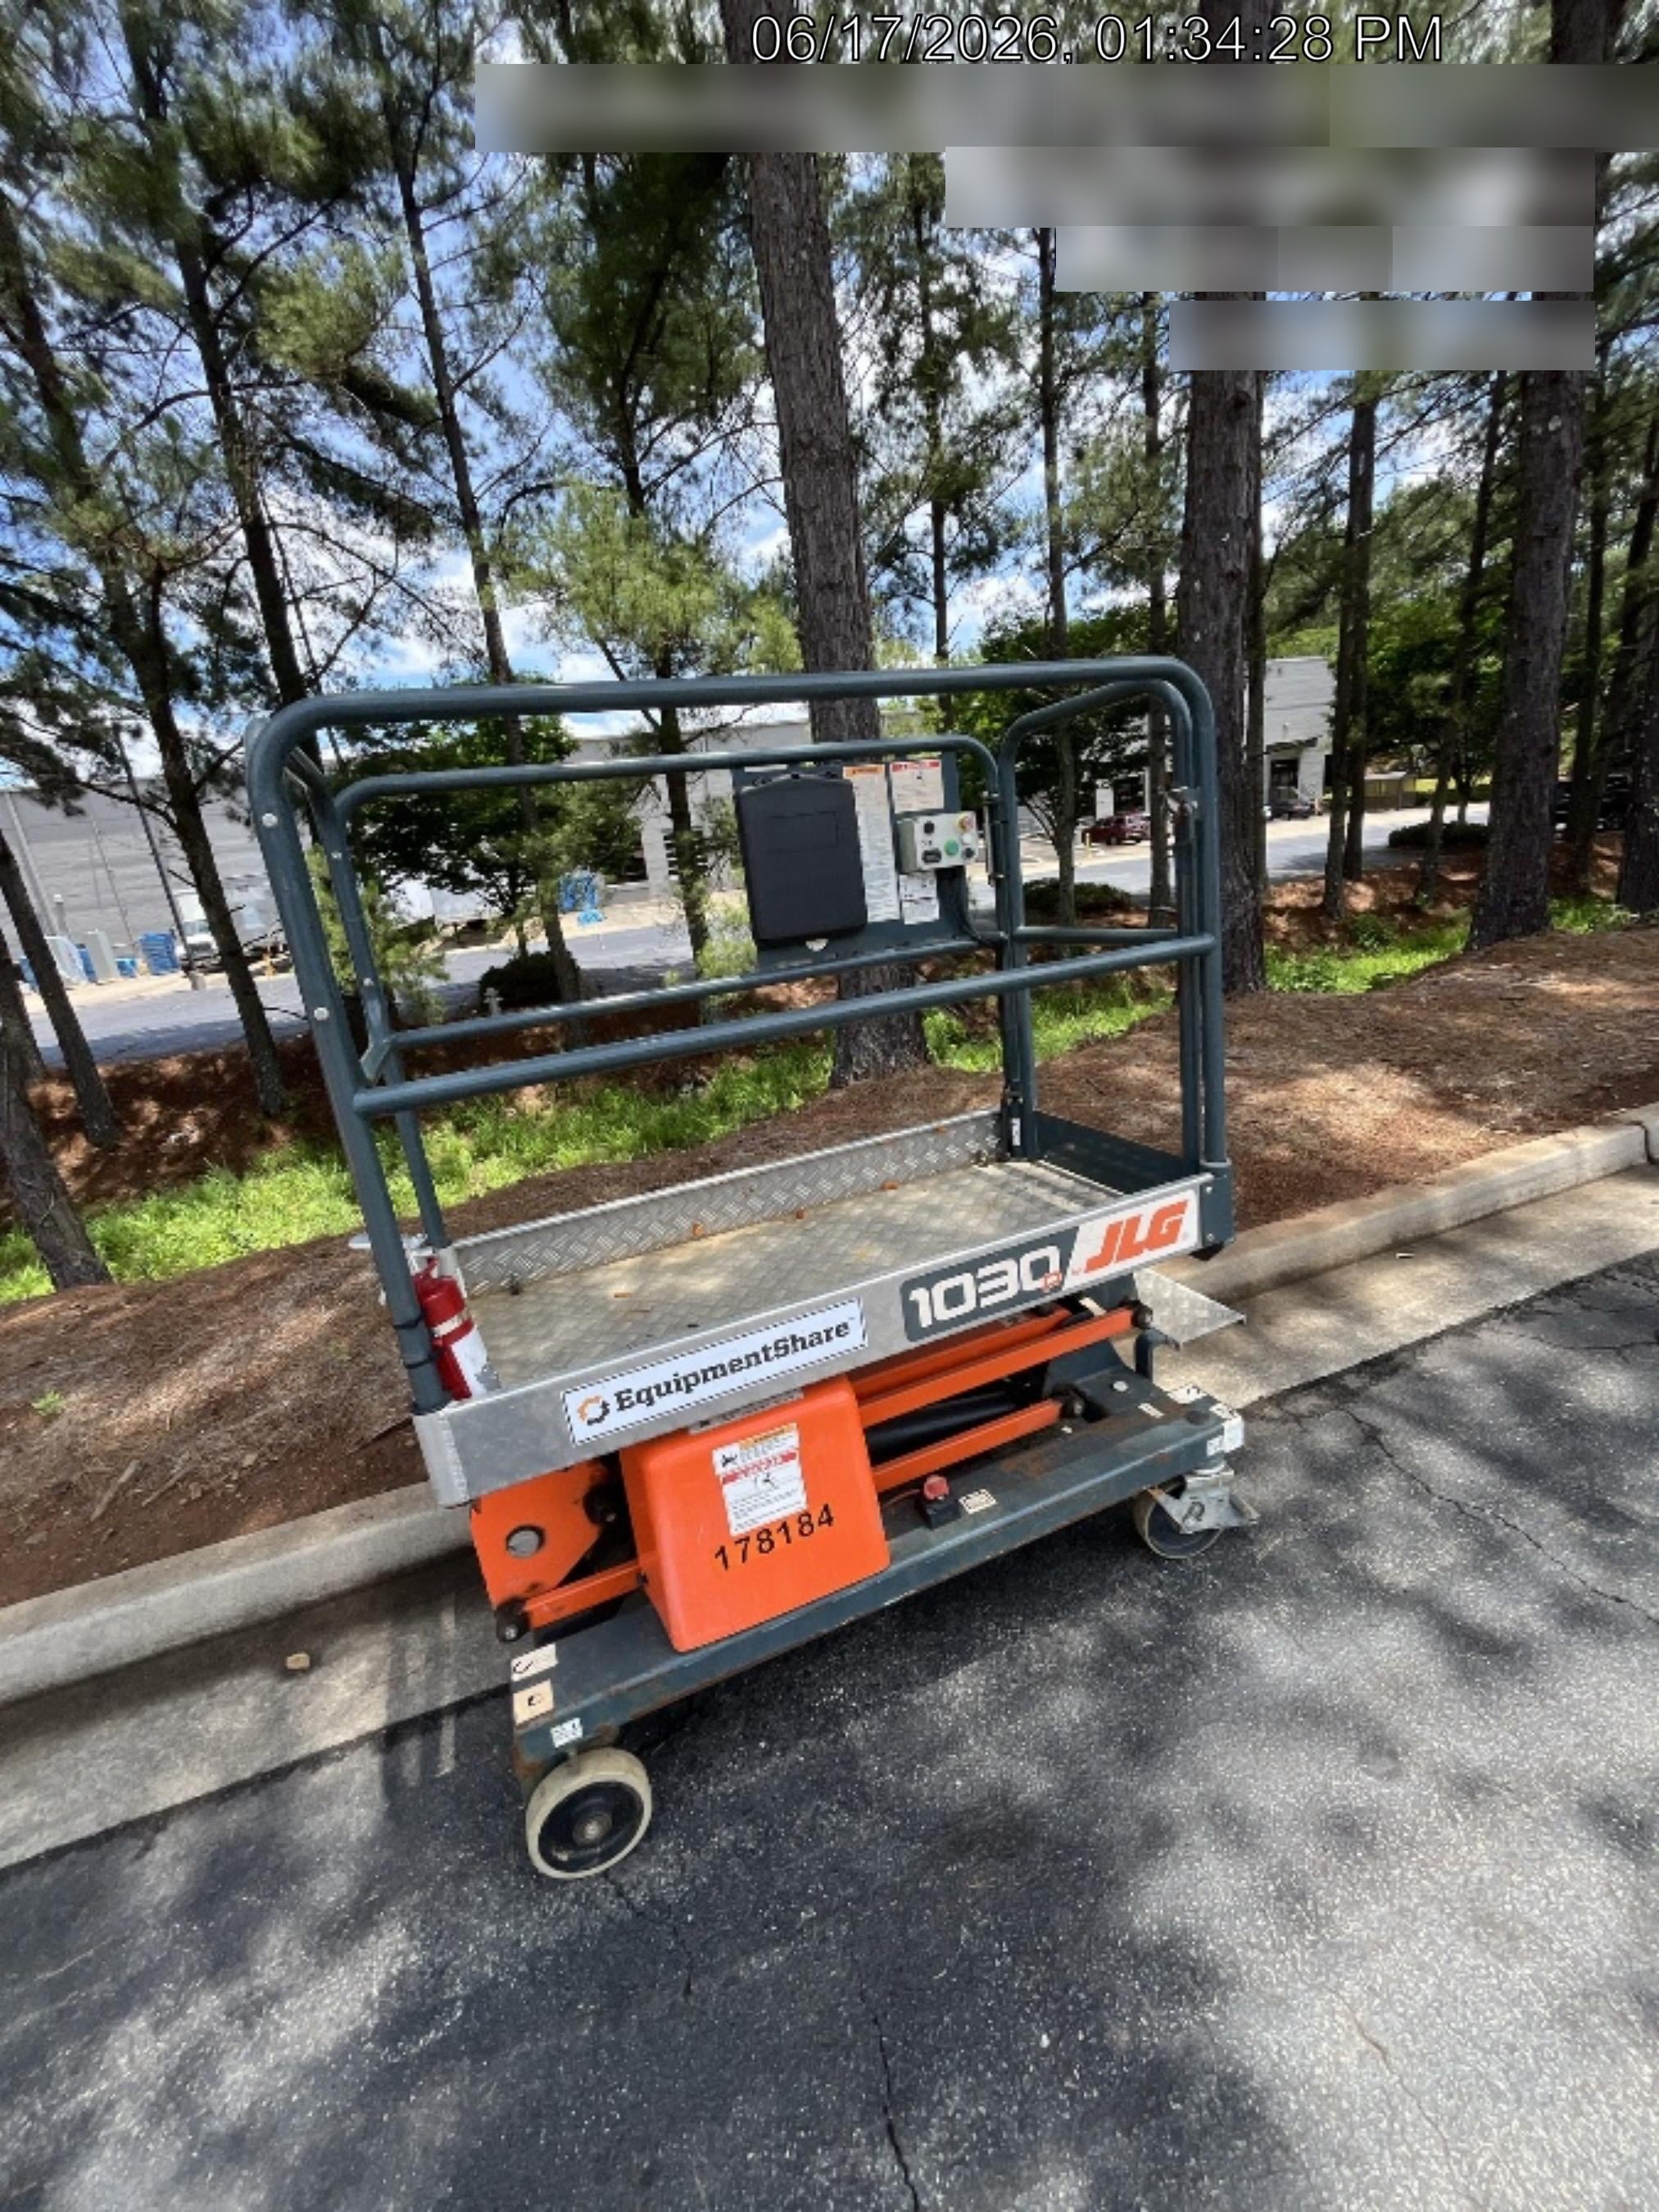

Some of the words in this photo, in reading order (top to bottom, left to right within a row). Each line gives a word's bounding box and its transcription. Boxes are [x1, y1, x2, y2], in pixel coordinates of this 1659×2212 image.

[1084, 1199, 1189, 1274] JLG
[909, 1244, 1060, 1328] 1030
[614, 1321, 850, 1412] EquipmentShare
[714, 1503, 834, 1571] 178184
